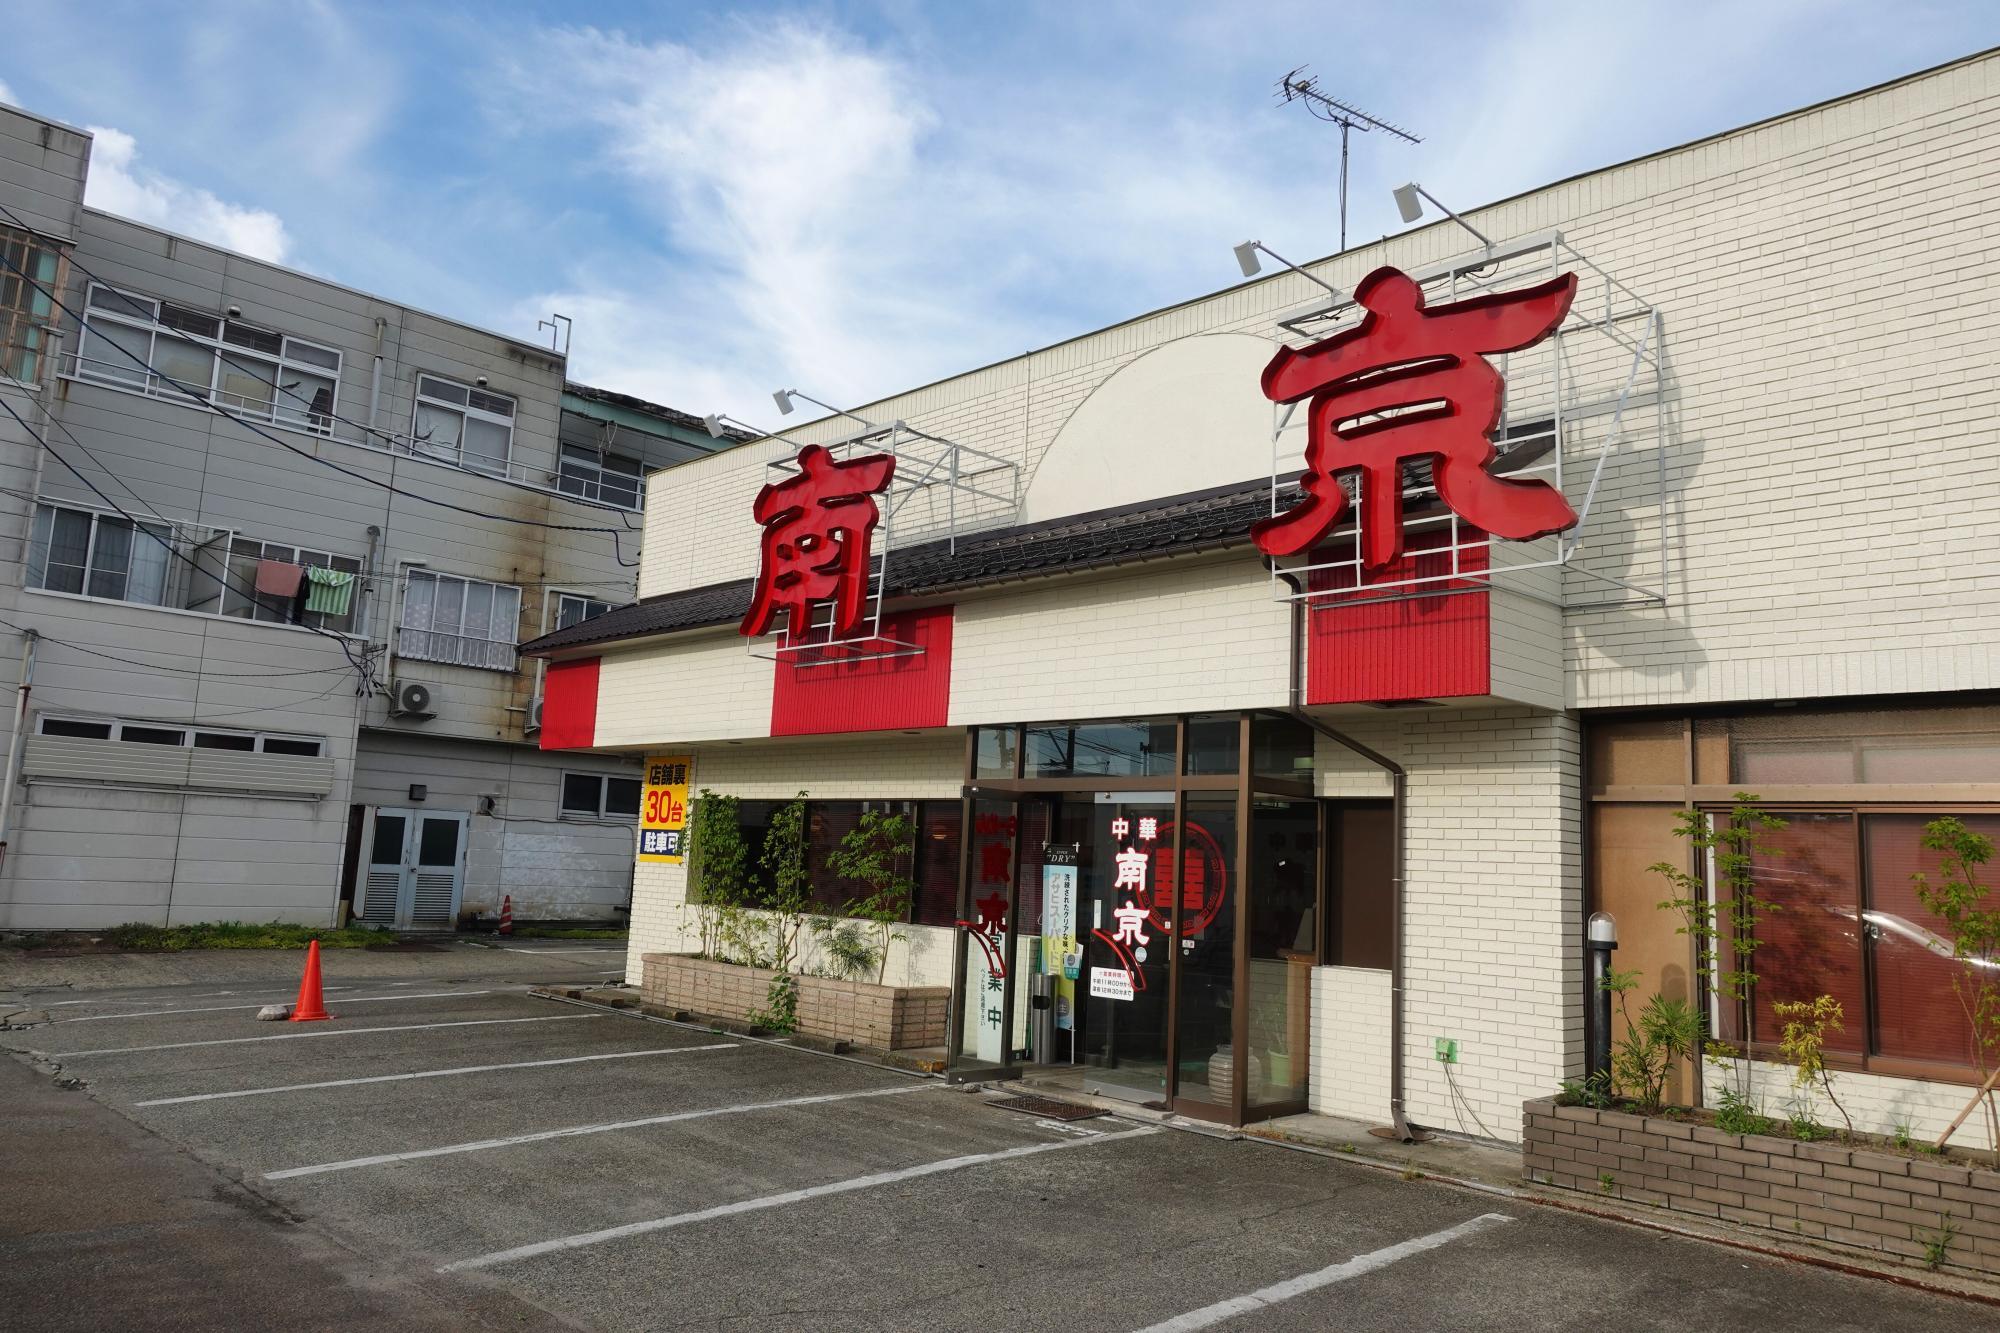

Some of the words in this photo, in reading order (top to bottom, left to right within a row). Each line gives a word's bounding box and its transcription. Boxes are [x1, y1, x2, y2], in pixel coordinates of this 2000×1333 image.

[739, 444, 897, 639] 南
[1251, 266, 1579, 570] 京
[649, 764, 687, 786] 店舗裏
[646, 790, 683, 823] 30台
[1112, 817, 1157, 840] 中華
[1112, 847, 1150, 946] 南京
